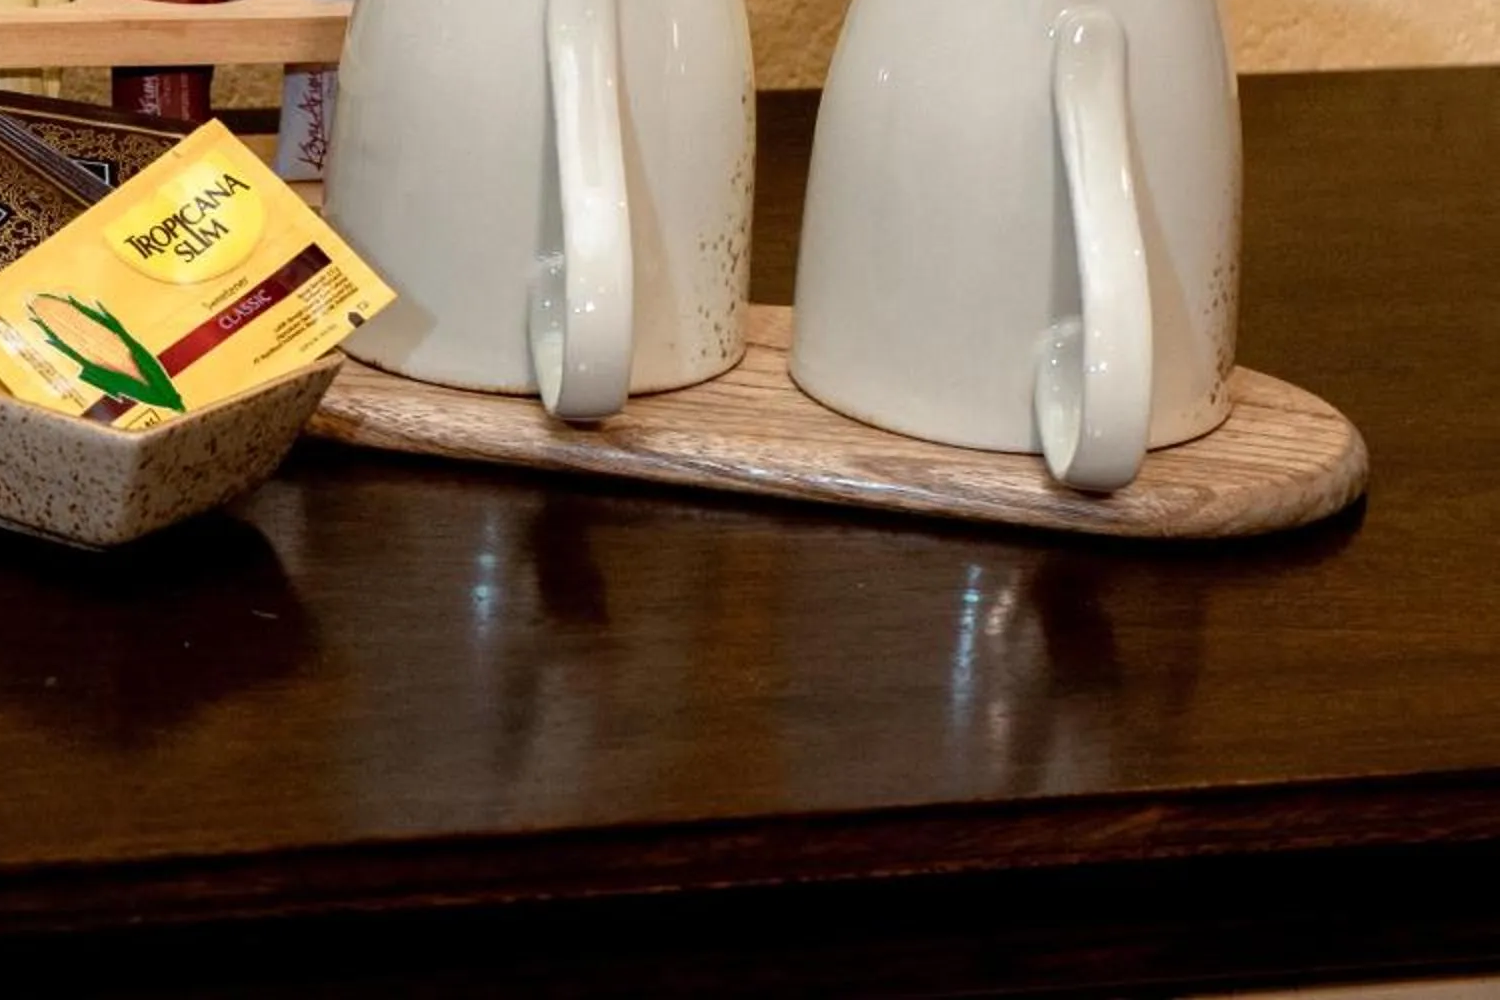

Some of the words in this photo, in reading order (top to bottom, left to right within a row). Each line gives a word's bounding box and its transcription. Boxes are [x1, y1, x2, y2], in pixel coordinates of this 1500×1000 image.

[124, 174, 250, 259] TROPICANA
[174, 219, 229, 263] SLIM
[218, 289, 272, 330] CLASSIC
